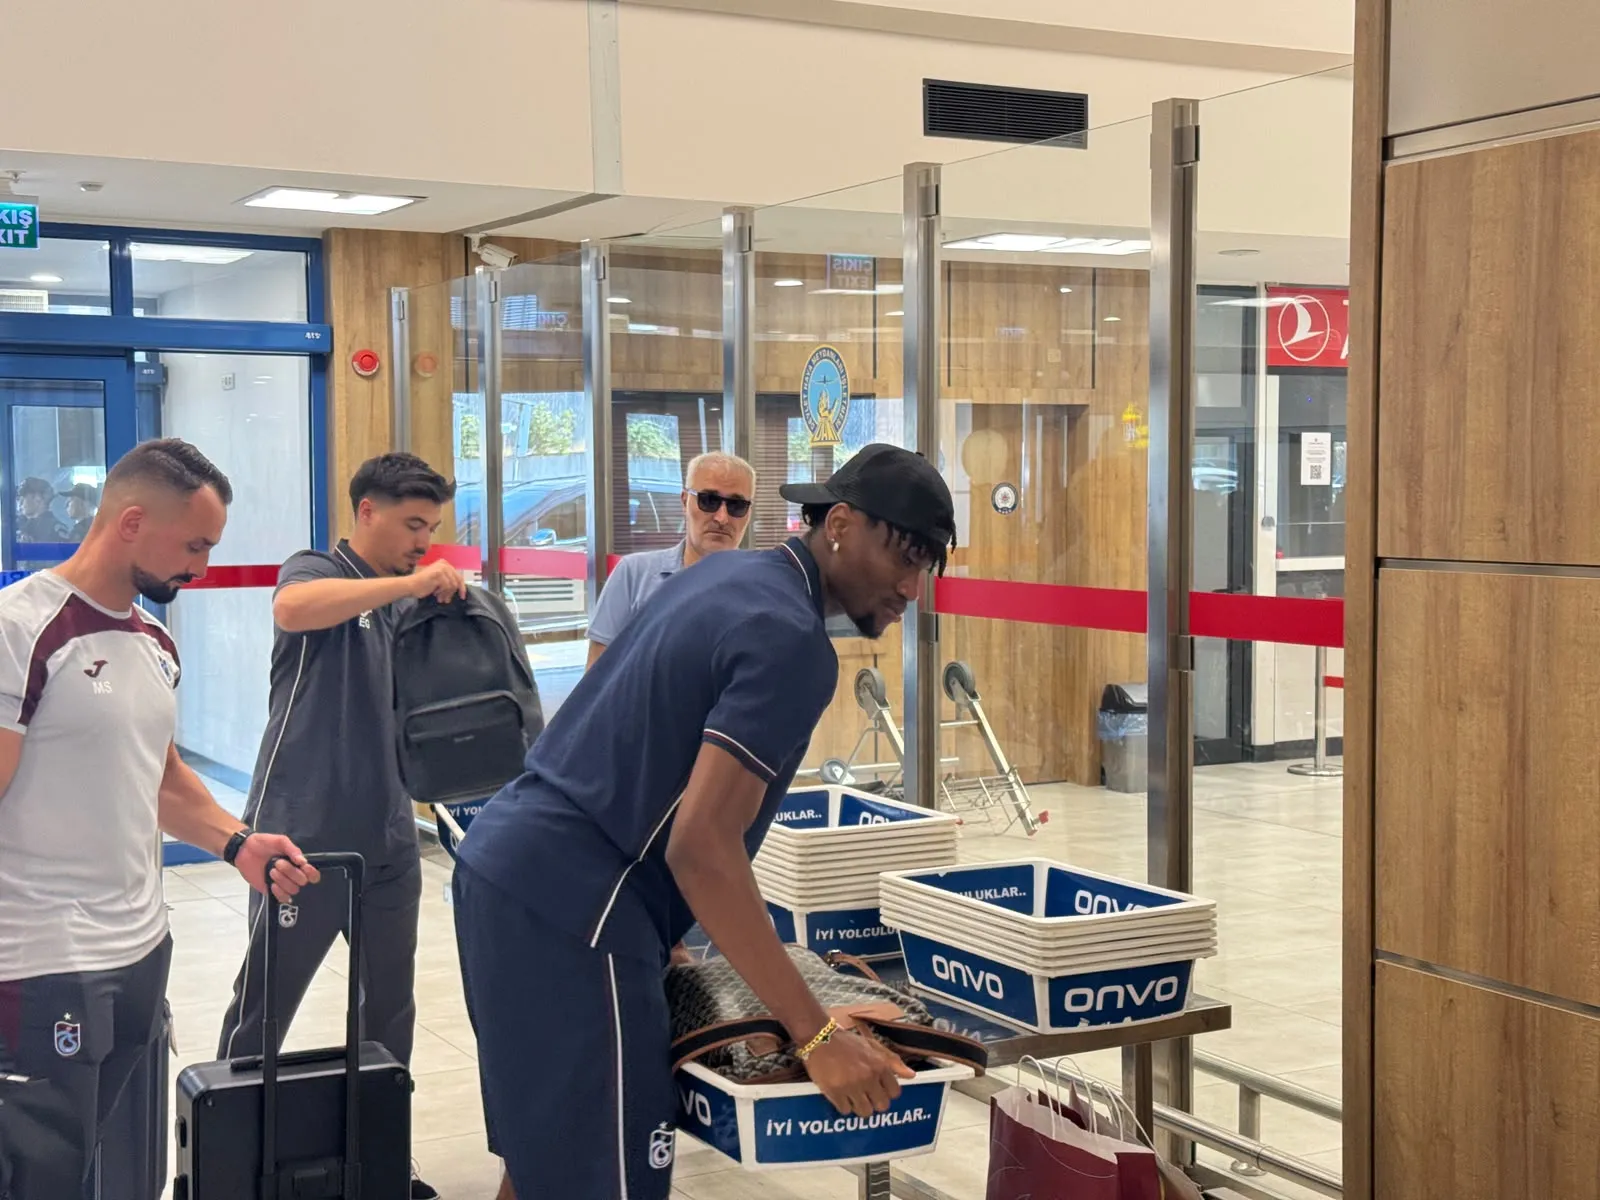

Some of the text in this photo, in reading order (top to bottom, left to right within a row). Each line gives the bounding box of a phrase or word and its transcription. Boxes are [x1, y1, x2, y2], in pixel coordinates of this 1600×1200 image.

[92, 680, 113, 695] MS
[449, 806, 460, 817] Yİ
[815, 926, 899, 941] İYİ YOLCULU
[766, 1106, 932, 1137] İYİ YOLCULUKLAR..
